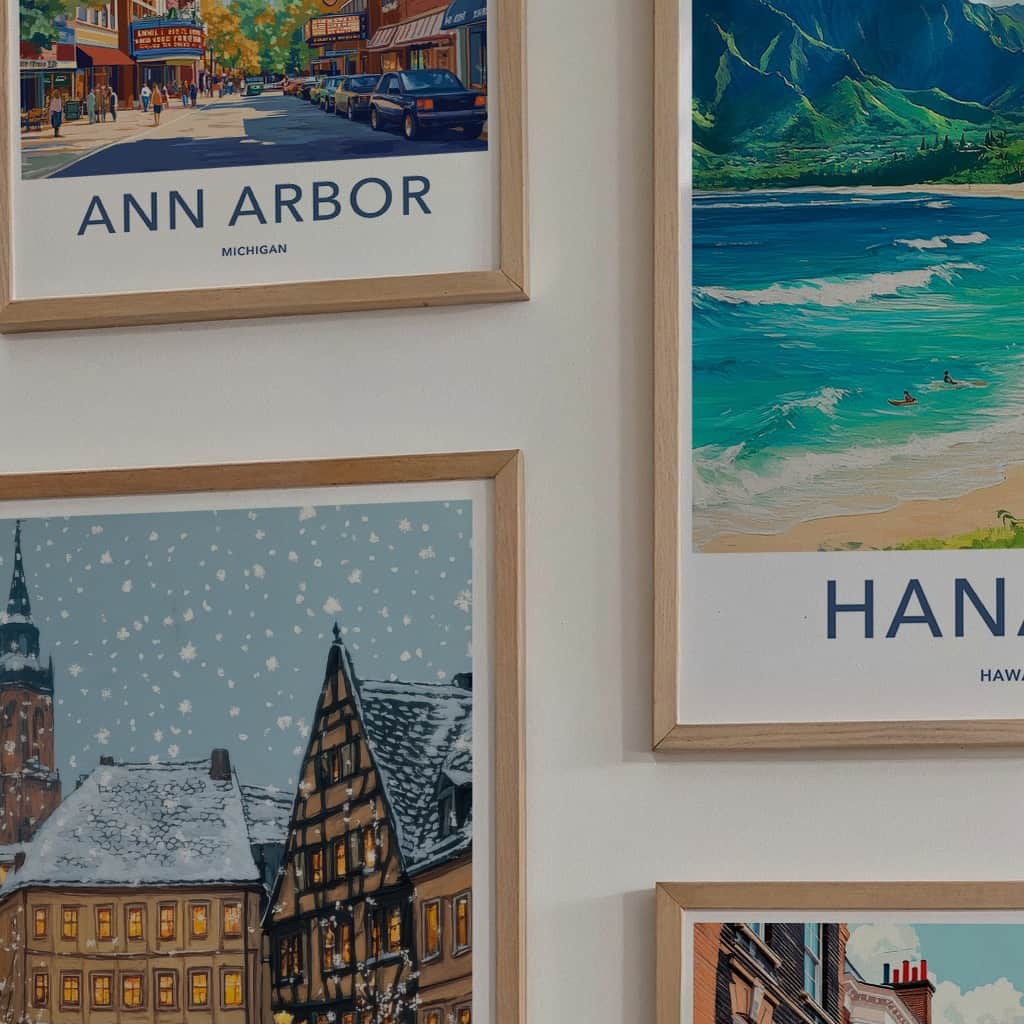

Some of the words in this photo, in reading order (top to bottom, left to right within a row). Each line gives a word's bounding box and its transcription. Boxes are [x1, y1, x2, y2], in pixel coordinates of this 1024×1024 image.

[77, 188, 204, 236] ANN
[228, 175, 432, 227] ARBOR
[221, 244, 288, 257] MICHIGAN
[827, 577, 1024, 639] HAN
[980, 668, 1024, 682] HAW
